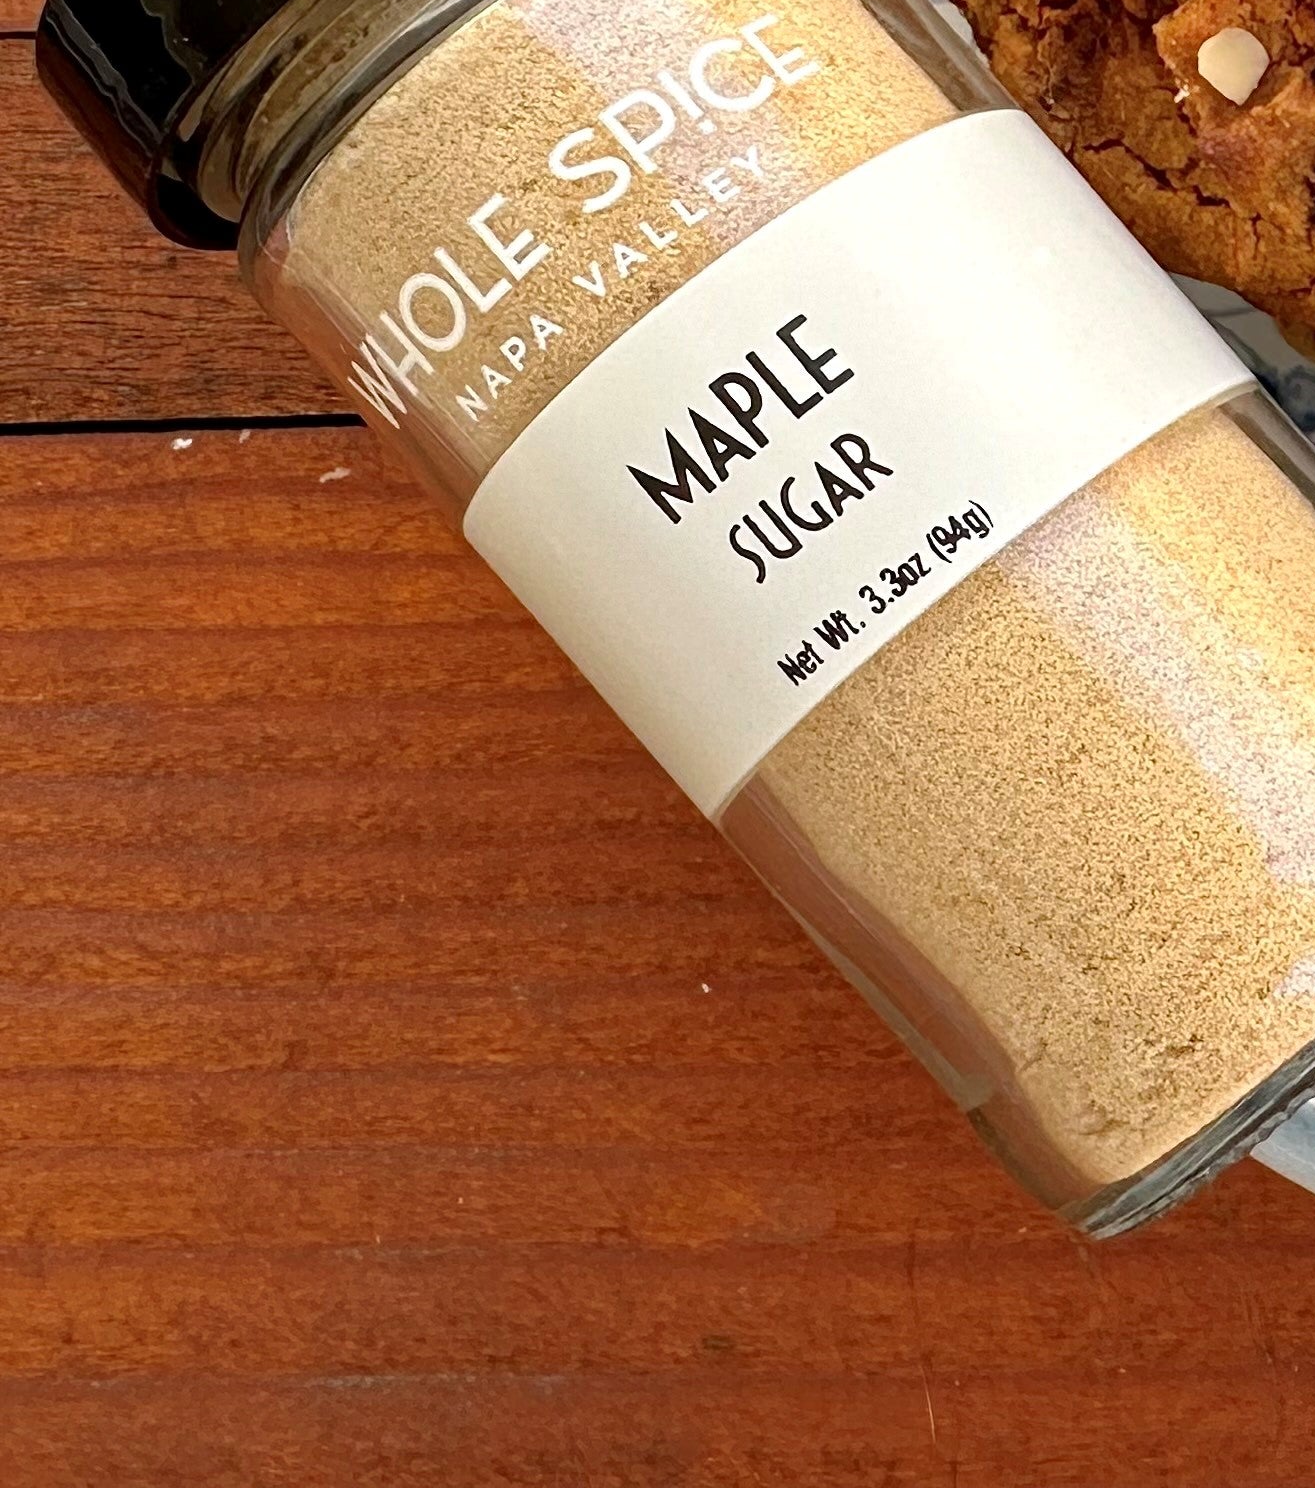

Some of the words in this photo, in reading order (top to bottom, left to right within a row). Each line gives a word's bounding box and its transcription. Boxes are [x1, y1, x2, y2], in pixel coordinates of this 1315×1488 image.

[347, 193, 553, 429] WHOLE
[548, 15, 822, 214] SPICE
[455, 314, 565, 422] NAPA
[572, 146, 766, 298] VALLEY
[626, 314, 854, 524] MAPLE
[729, 433, 893, 584] SUGAR
[777, 640, 825, 686] Net
[813, 610, 866, 651] Wt.
[858, 552, 931, 614] 3.3oz
[925, 500, 994, 564] (94g)
